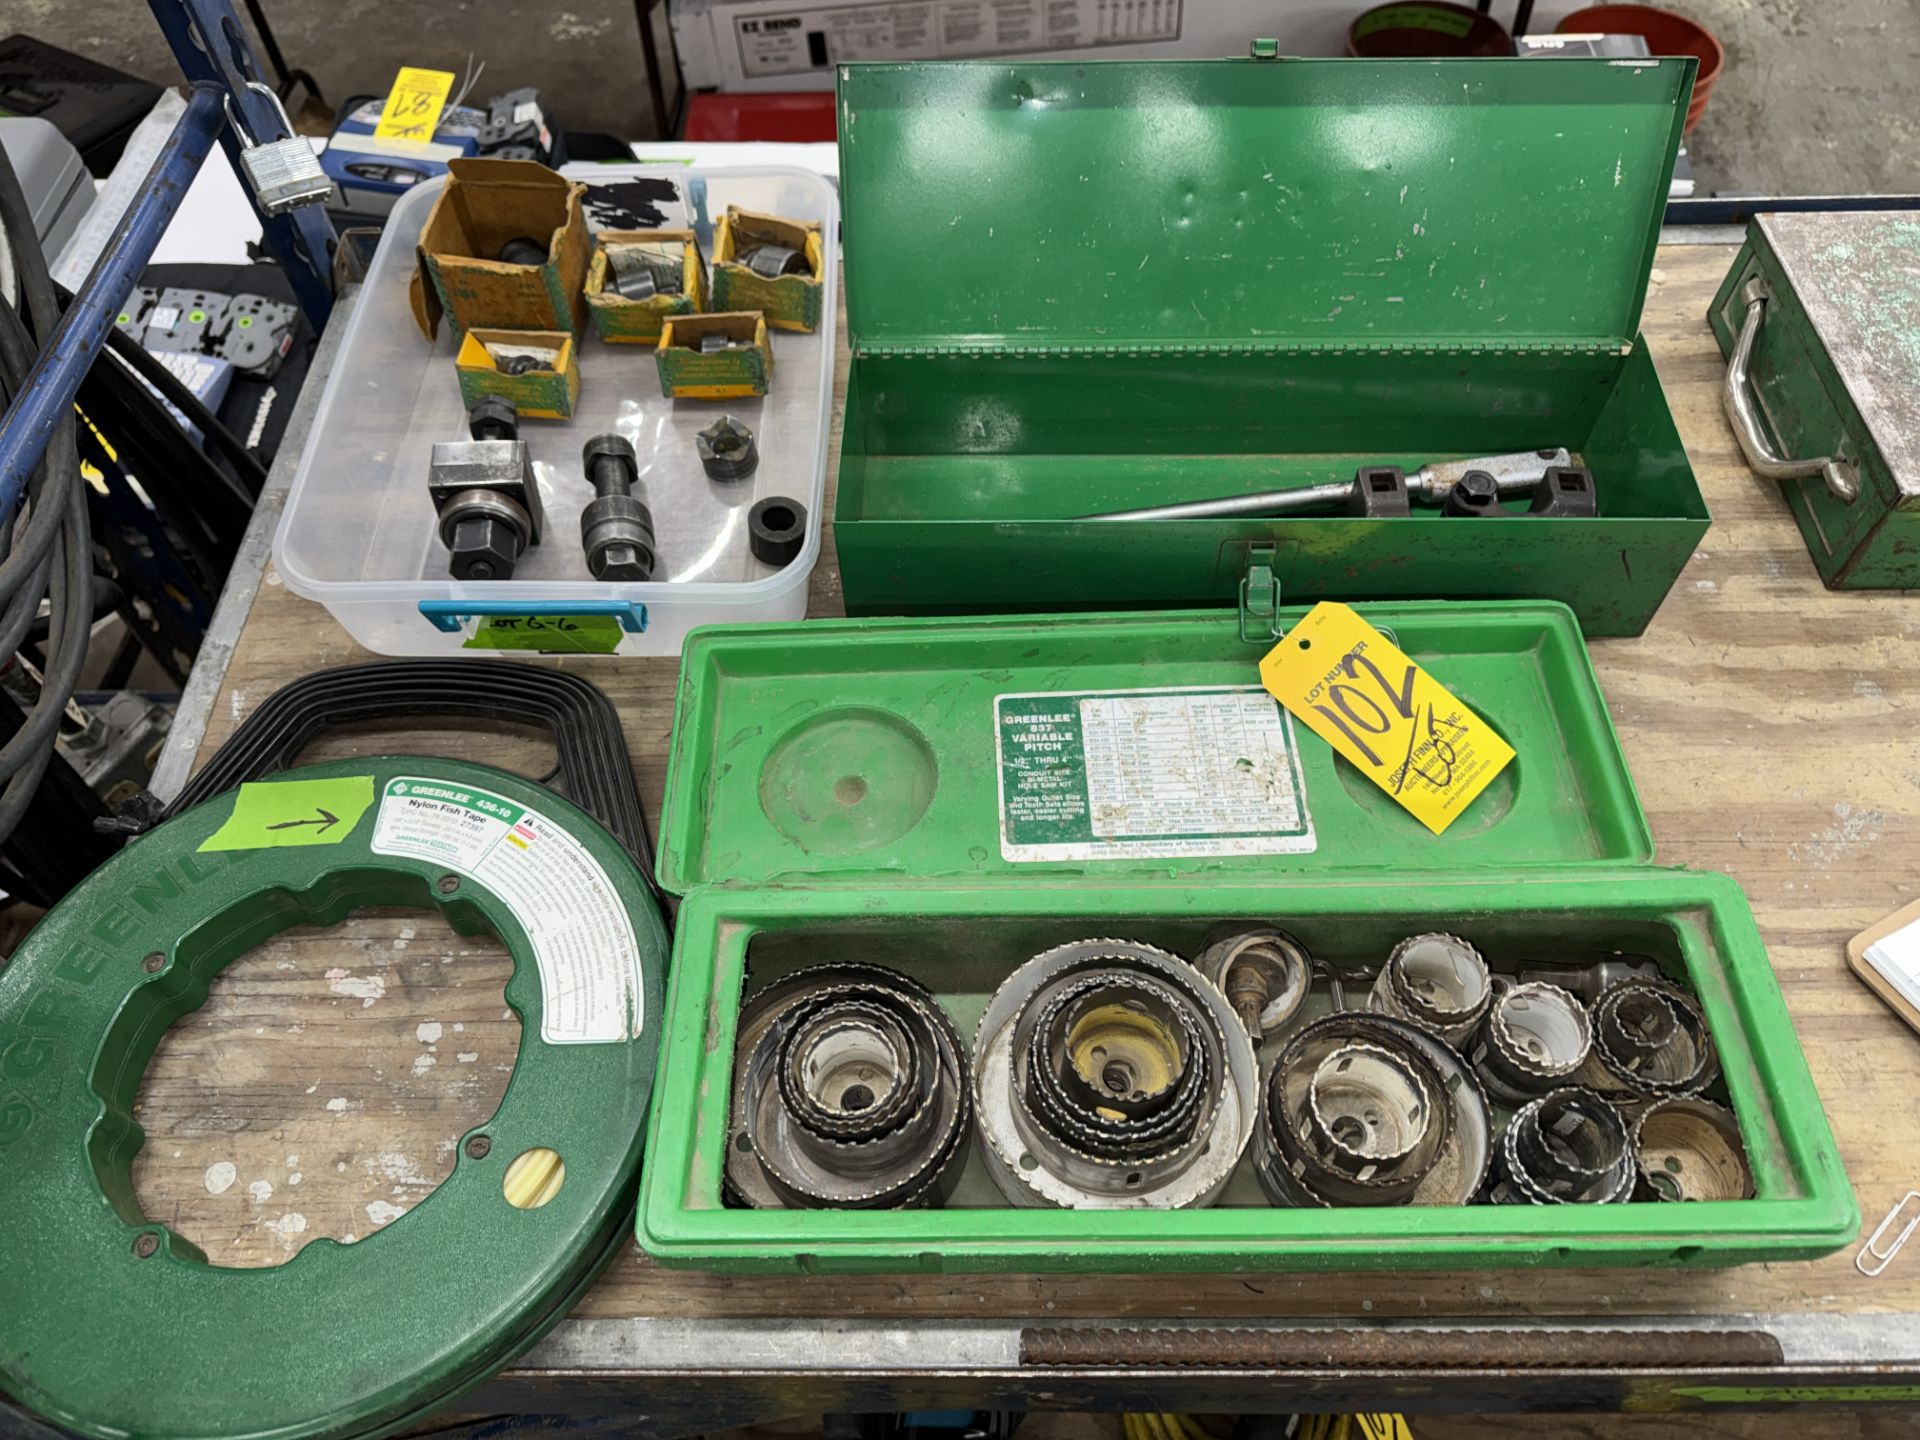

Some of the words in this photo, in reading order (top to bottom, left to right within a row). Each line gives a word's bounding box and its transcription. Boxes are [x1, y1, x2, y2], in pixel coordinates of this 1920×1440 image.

[1303, 680, 1327, 705] LOT
[1322, 637, 1368, 685] NUER
[1005, 714, 1071, 724] GREENLEE
[1312, 653, 1417, 767] 102
[1012, 732, 1073, 743] VARIABLE
[1030, 724, 1052, 732] 837
[1024, 742, 1062, 752] PITCH
[1412, 738, 1434, 760] FINN
[1034, 756, 1058, 764] THRU
[1060, 780, 1072, 788] KIT
[409, 799, 438, 810] Nylon
[440, 804, 460, 816] Fish
[464, 810, 487, 824] Tape
[412, 786, 471, 802] GREENLEE
[476, 800, 512, 818] 436-10
[535, 823, 553, 840] Read
[563, 845, 594, 881] understand
[2, 847, 258, 1081] GREENL
